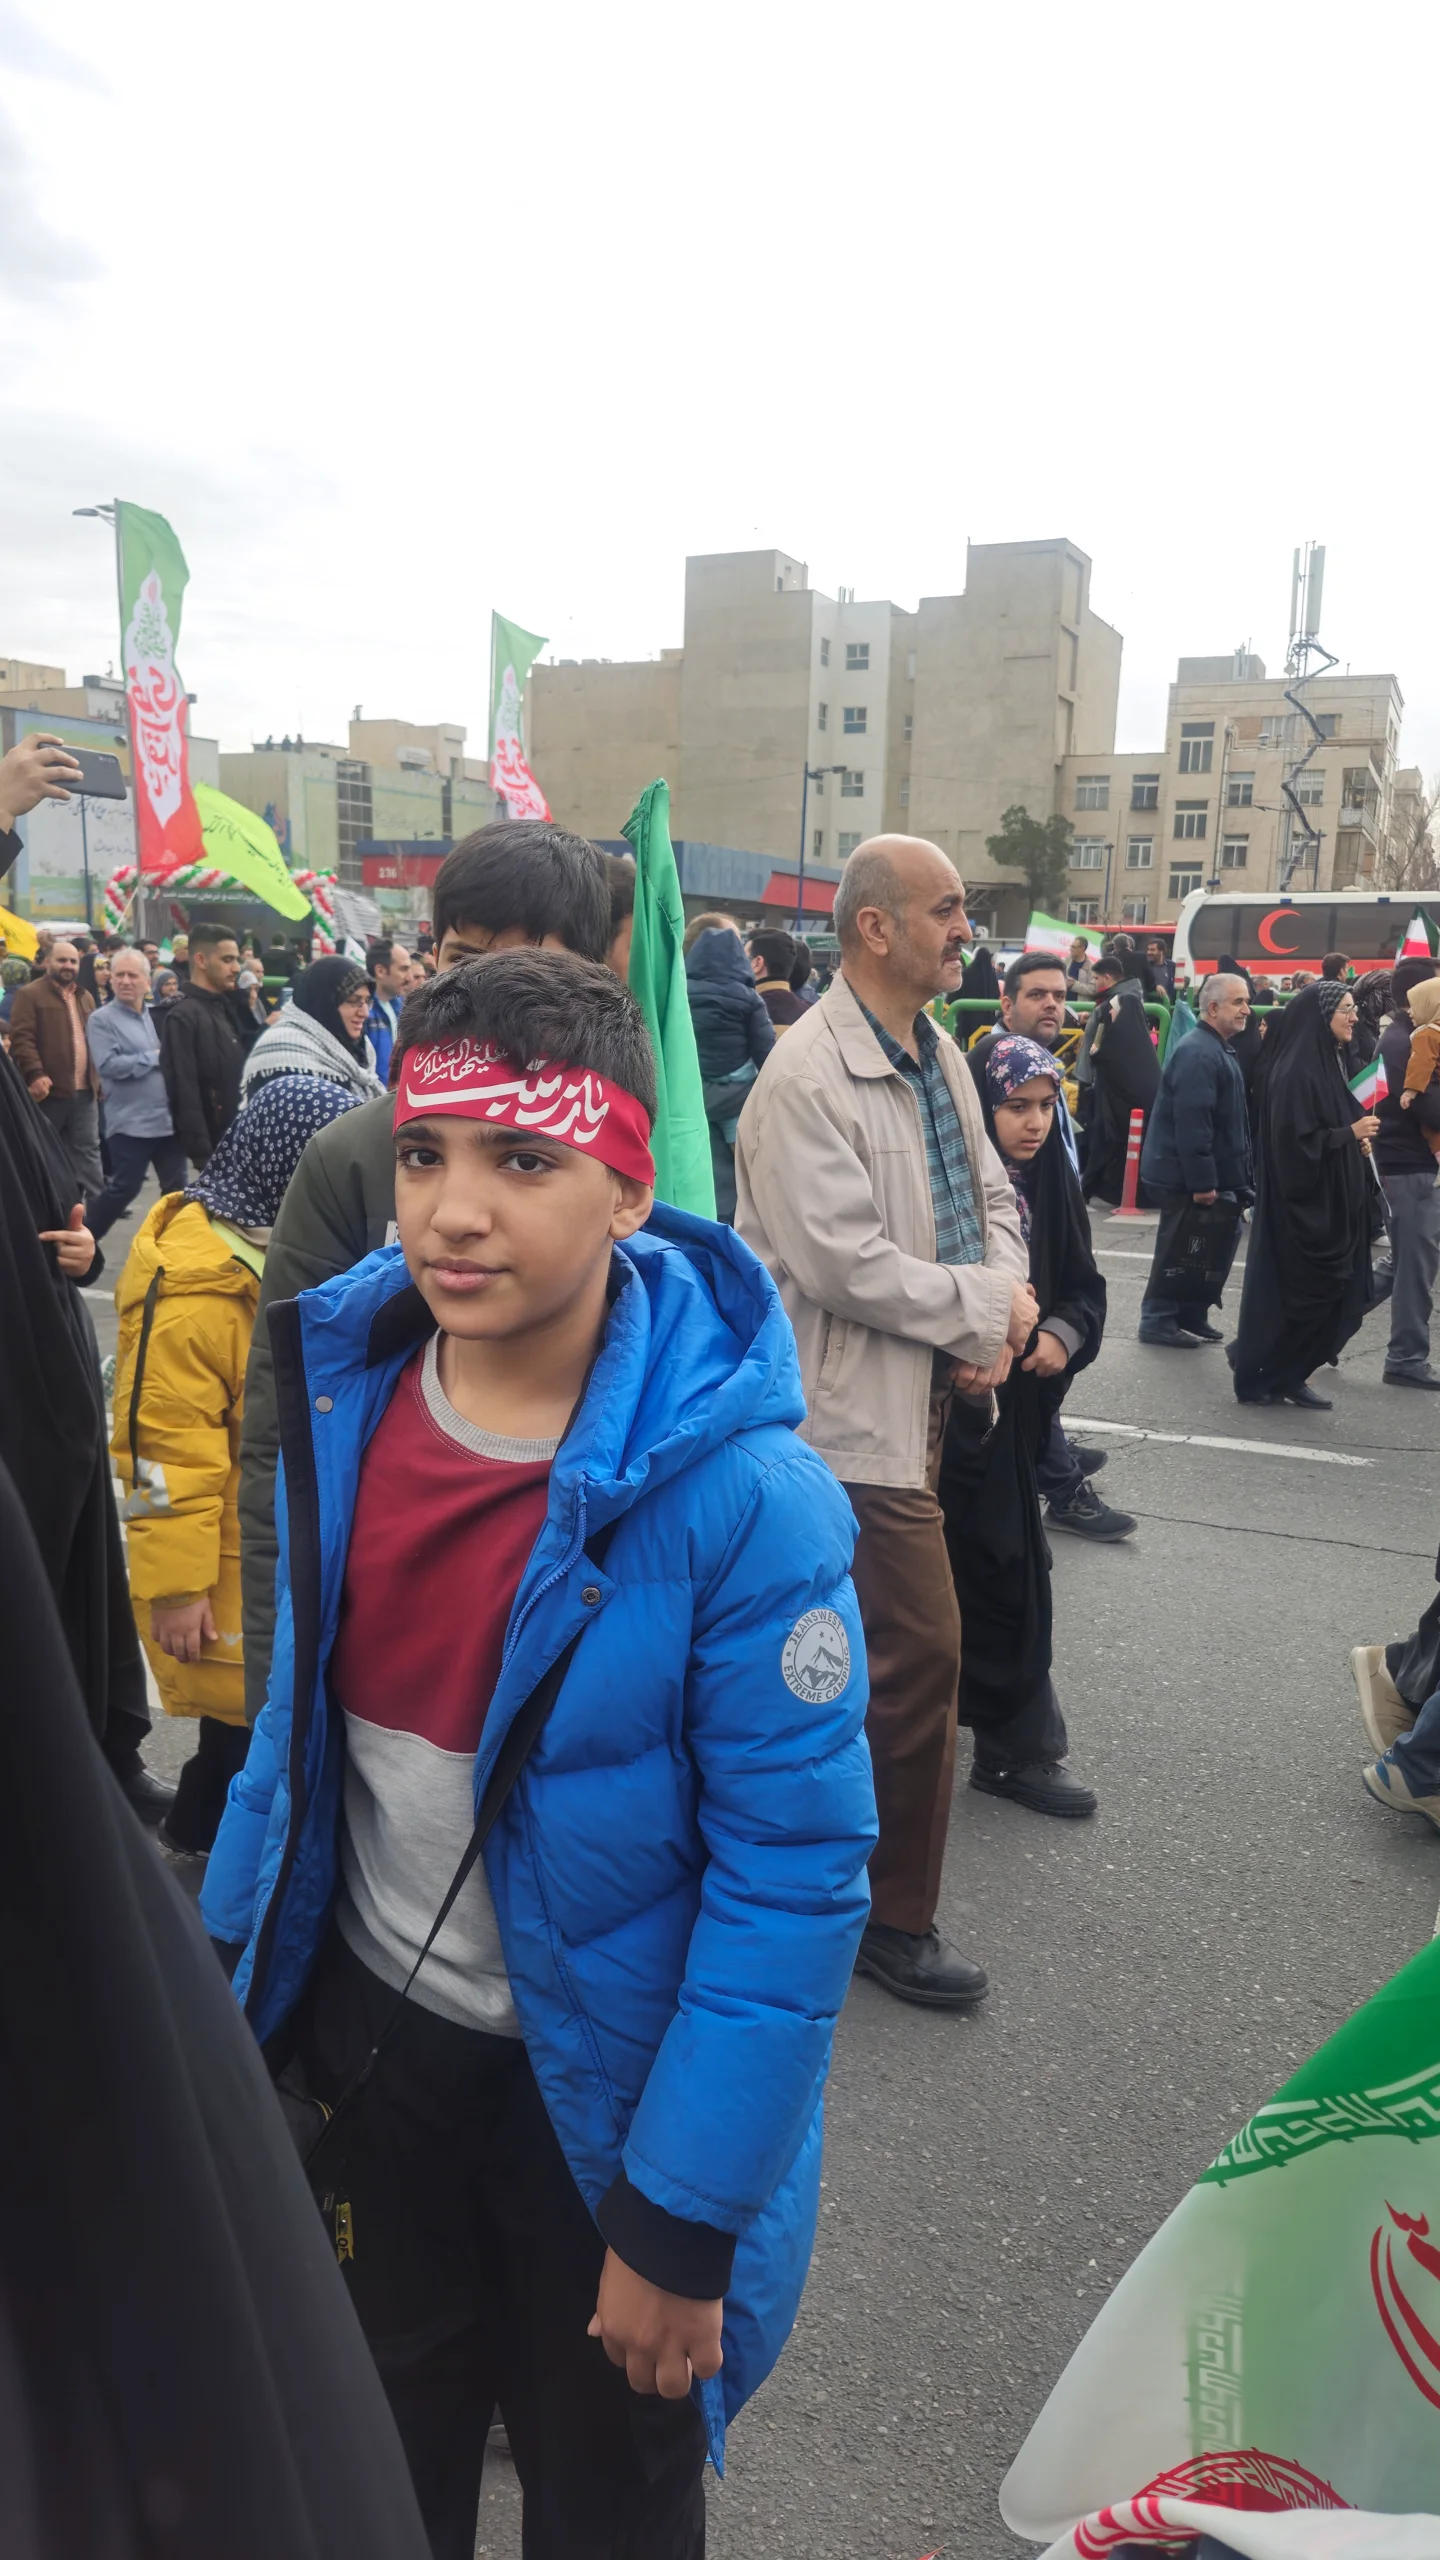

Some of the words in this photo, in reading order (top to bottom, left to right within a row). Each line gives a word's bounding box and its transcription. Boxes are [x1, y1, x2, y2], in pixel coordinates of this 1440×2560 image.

[788, 1610, 841, 1645] JEANSWEST
[783, 1664, 822, 1702] EXTREME
[826, 1647, 850, 1700] CAMPING
